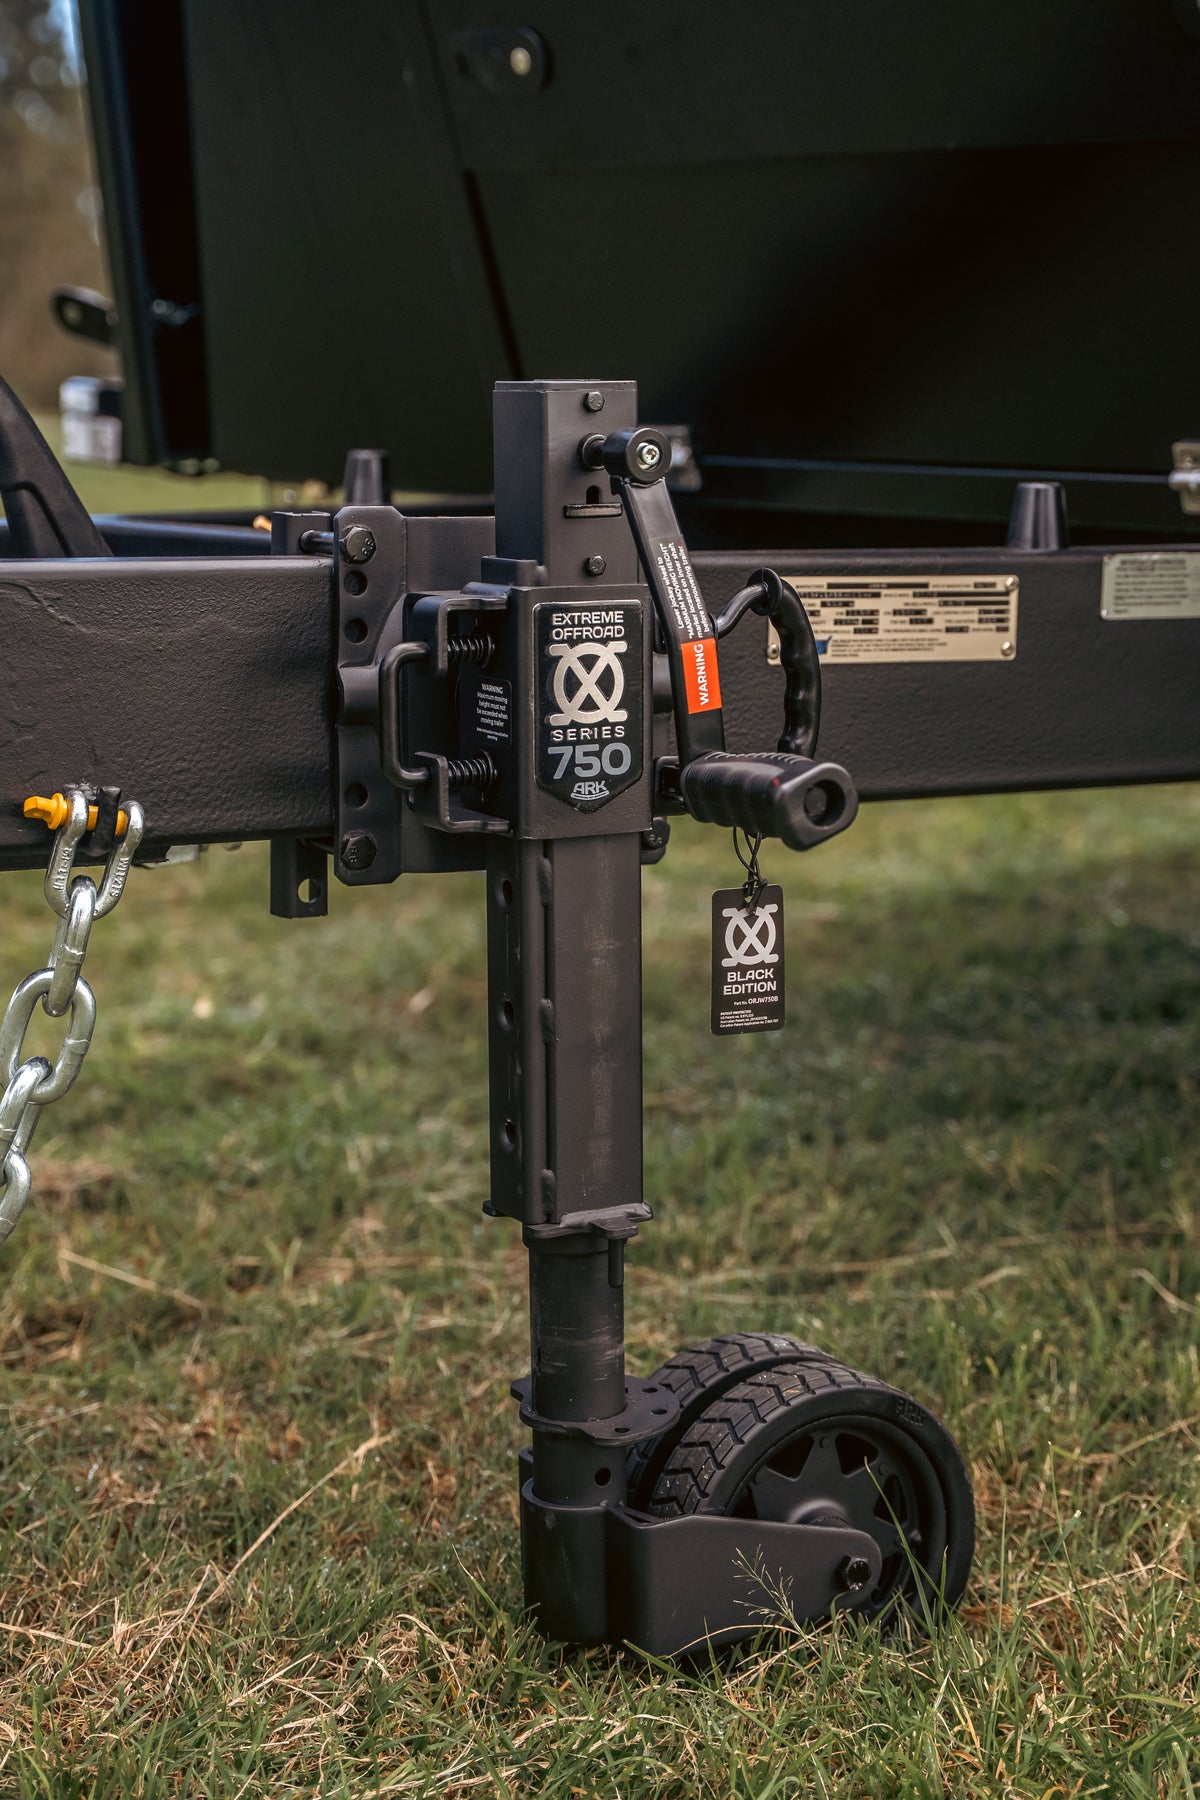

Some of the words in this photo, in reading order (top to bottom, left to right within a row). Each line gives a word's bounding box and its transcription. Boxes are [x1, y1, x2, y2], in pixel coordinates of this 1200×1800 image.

[668, 542, 678, 559] shaft
[678, 546, 688, 565] trailer
[657, 557, 663, 565] to
[675, 560, 685, 578] inner
[659, 565, 670, 585] wheel
[681, 578, 687, 587] on
[670, 572, 683, 600] MOVING
[685, 566, 702, 609] manouvering
[667, 586, 679, 608] jockey
[683, 589, 695, 613] located
[552, 611, 624, 626] EXTREME
[674, 608, 684, 628] Lower
[692, 614, 703, 638] marker
[700, 610, 710, 632] before
[552, 626, 624, 640] OFFROAD
[694, 643, 710, 706] WARNING
[482, 683, 503, 694] WARNING
[494, 696, 508, 704] moving
[552, 726, 625, 741] SERIES
[548, 742, 632, 780] 750
[574, 780, 608, 794] ARK
[727, 968, 774, 982] BLACK
[723, 981, 776, 995] EDITION
